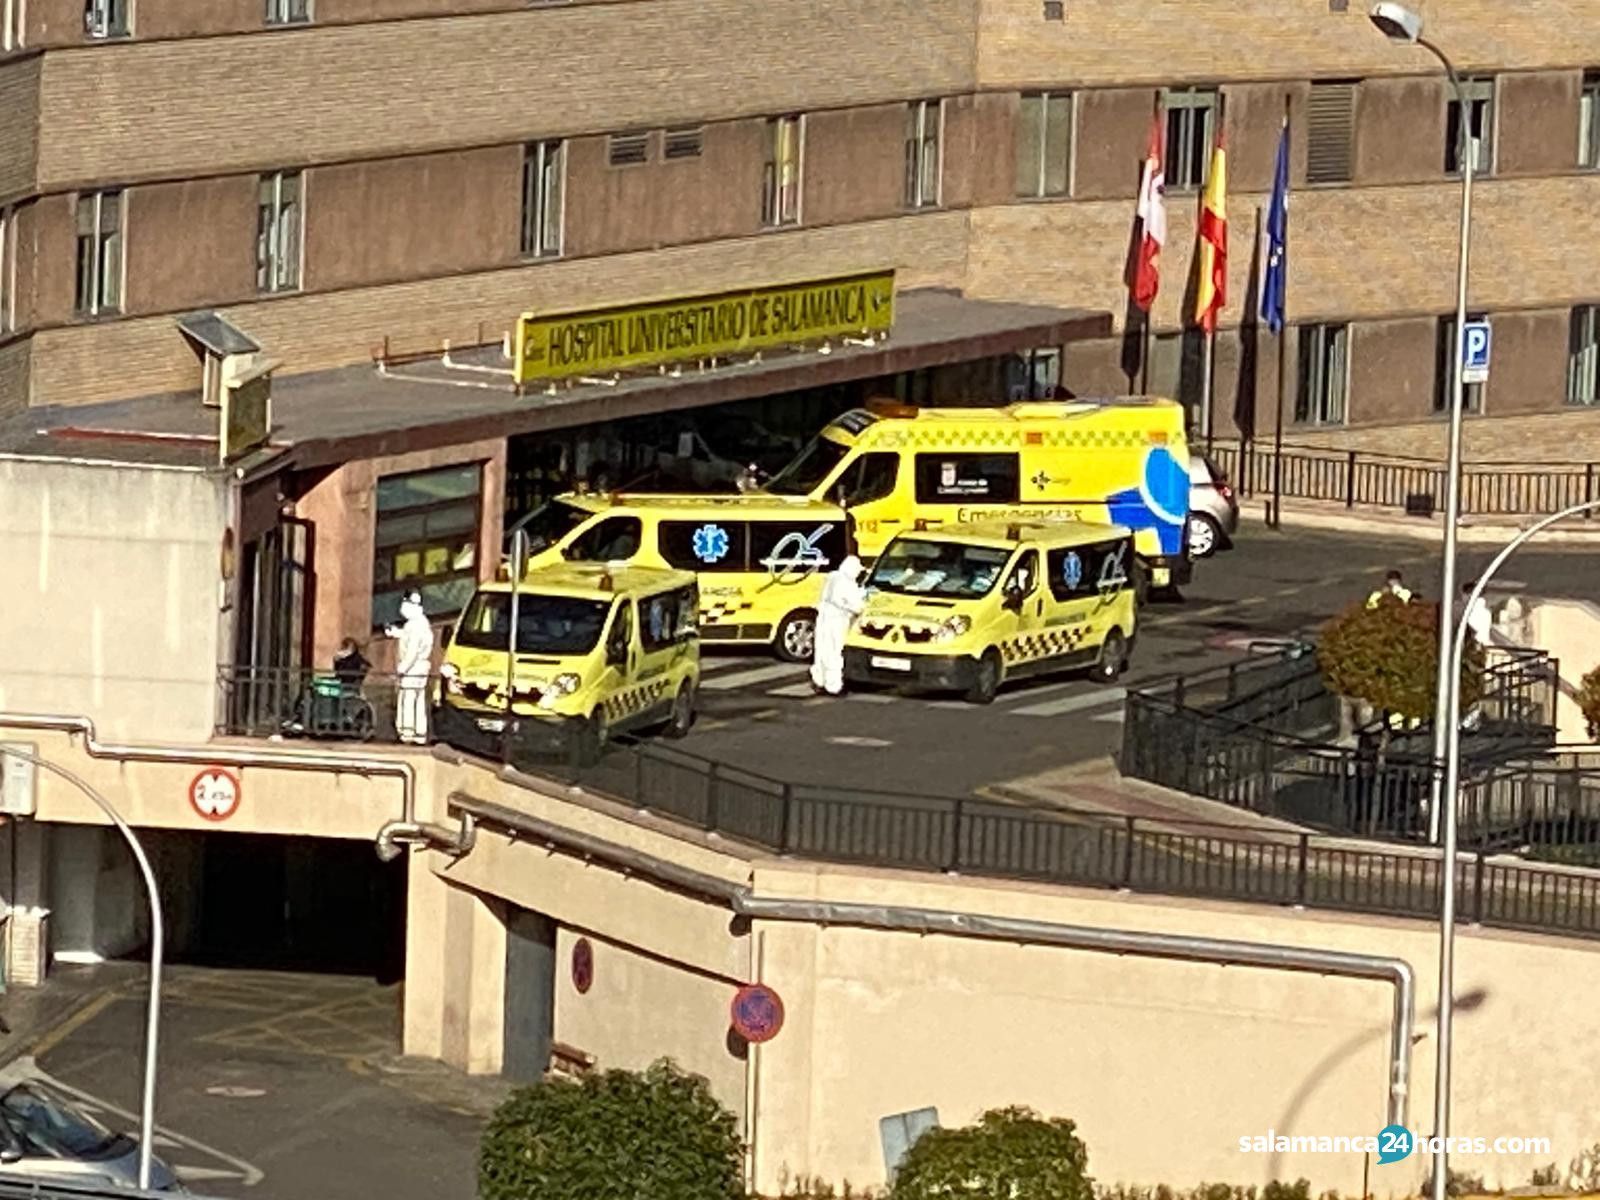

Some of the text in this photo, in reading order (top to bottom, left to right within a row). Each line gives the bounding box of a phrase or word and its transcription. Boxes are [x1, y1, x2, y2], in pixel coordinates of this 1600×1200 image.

[549, 284, 867, 367] HOSPITAL UNIVERSITARIO DE SALAMANCA
[1468, 329, 1486, 364] P
